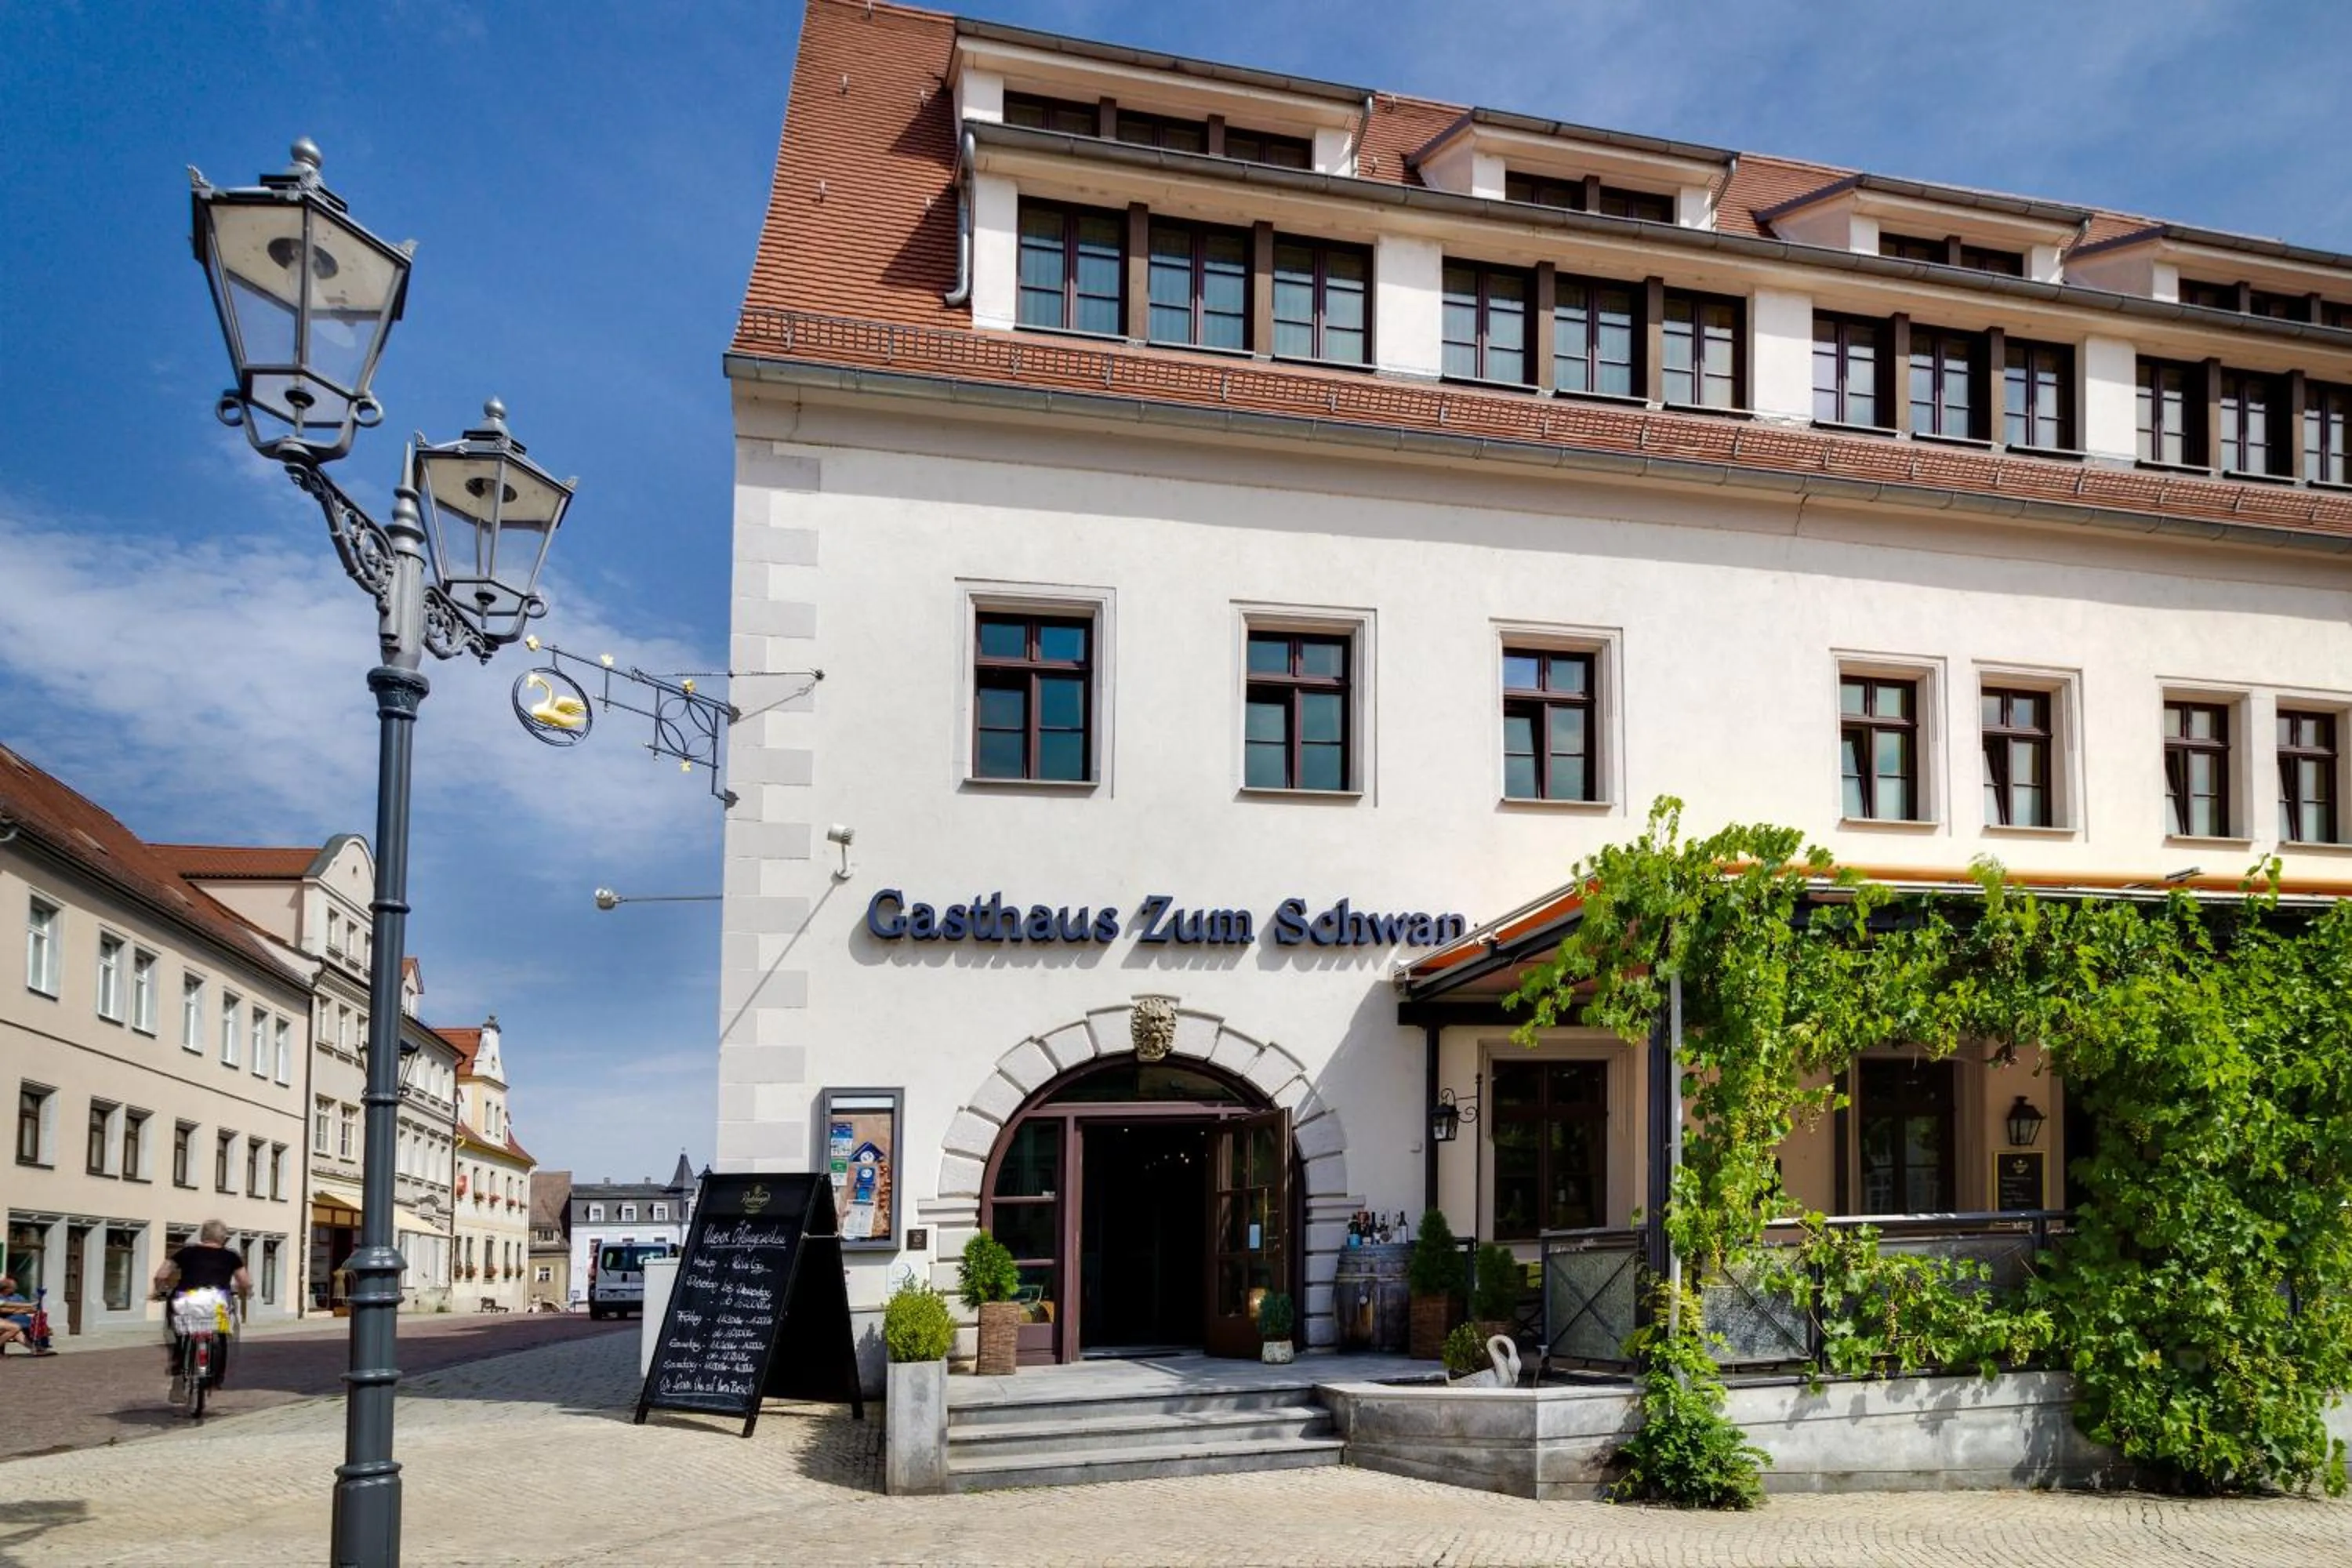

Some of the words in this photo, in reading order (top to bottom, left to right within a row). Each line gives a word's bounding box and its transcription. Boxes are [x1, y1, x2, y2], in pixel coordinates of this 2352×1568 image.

[866, 888, 1120, 942] Gasthaus
[1138, 895, 1254, 944] Zum
[1275, 897, 1466, 946] Schwan
